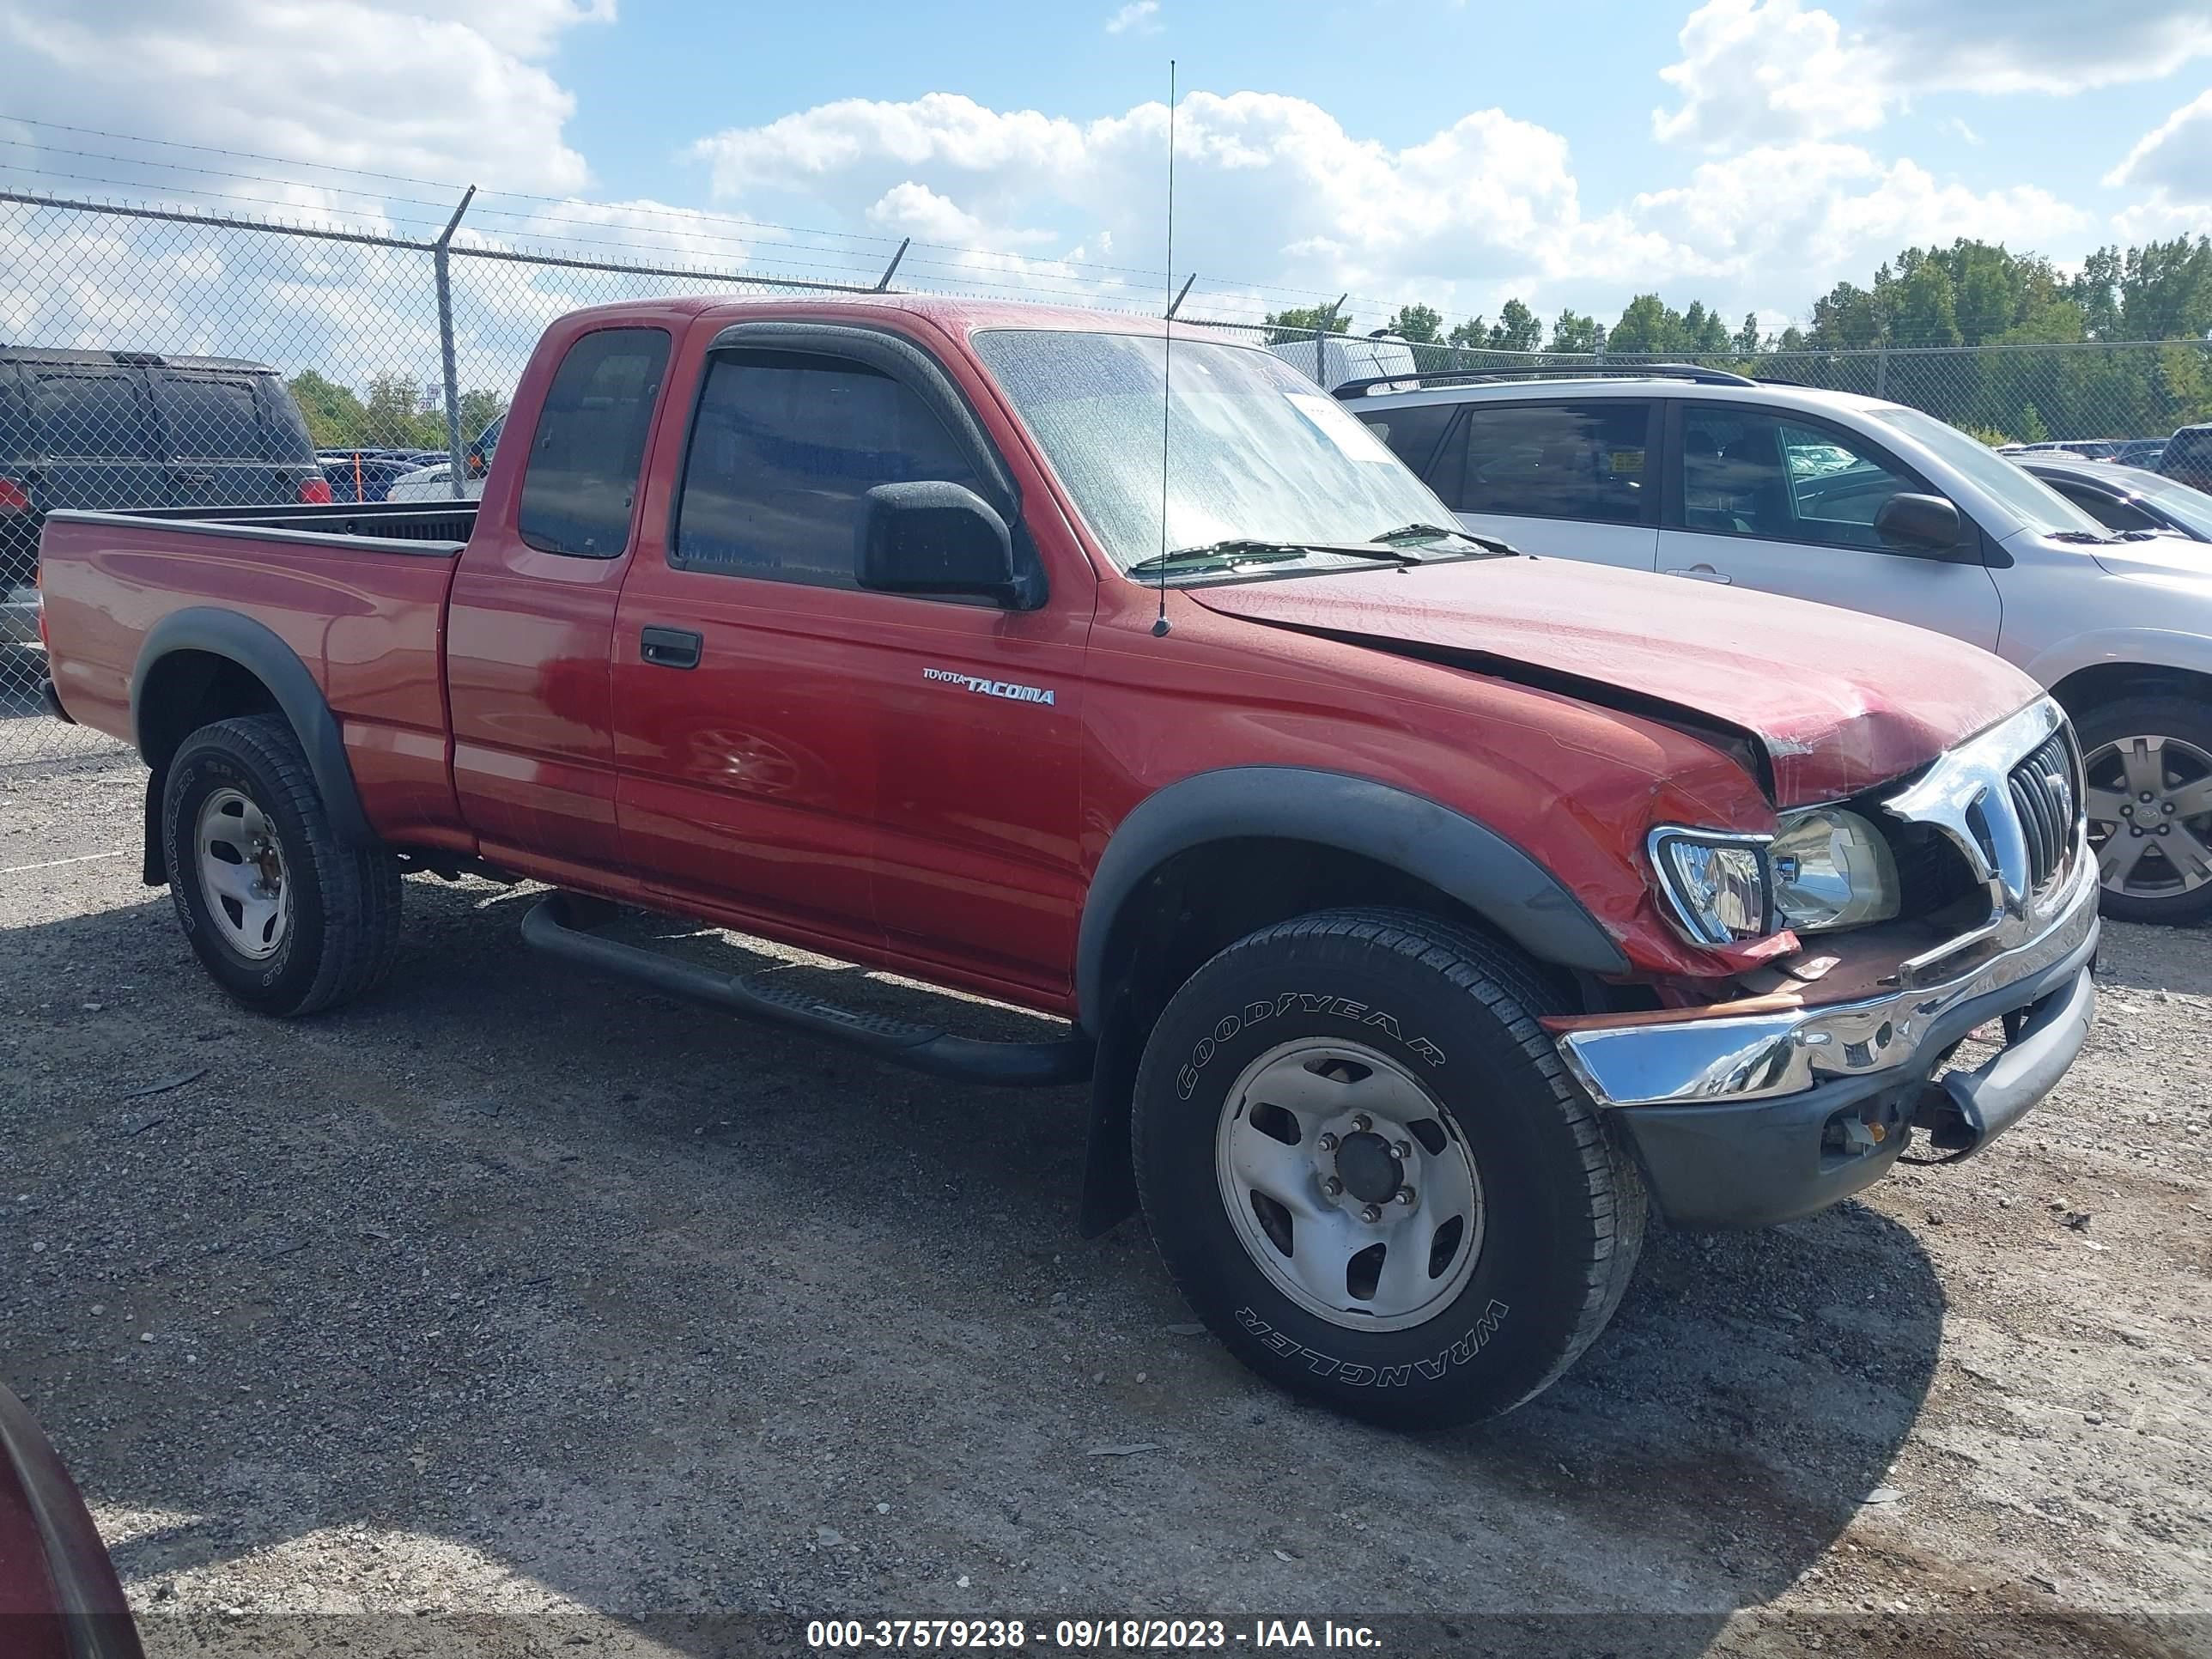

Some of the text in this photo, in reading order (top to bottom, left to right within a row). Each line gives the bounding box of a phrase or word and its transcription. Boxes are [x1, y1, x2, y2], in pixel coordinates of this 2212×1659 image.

[922, 667, 1055, 706] TOYOTA TACOMA
[1176, 993, 1447, 1100] GOODYEAR
[1235, 1299, 1510, 1388] WRANGLER
